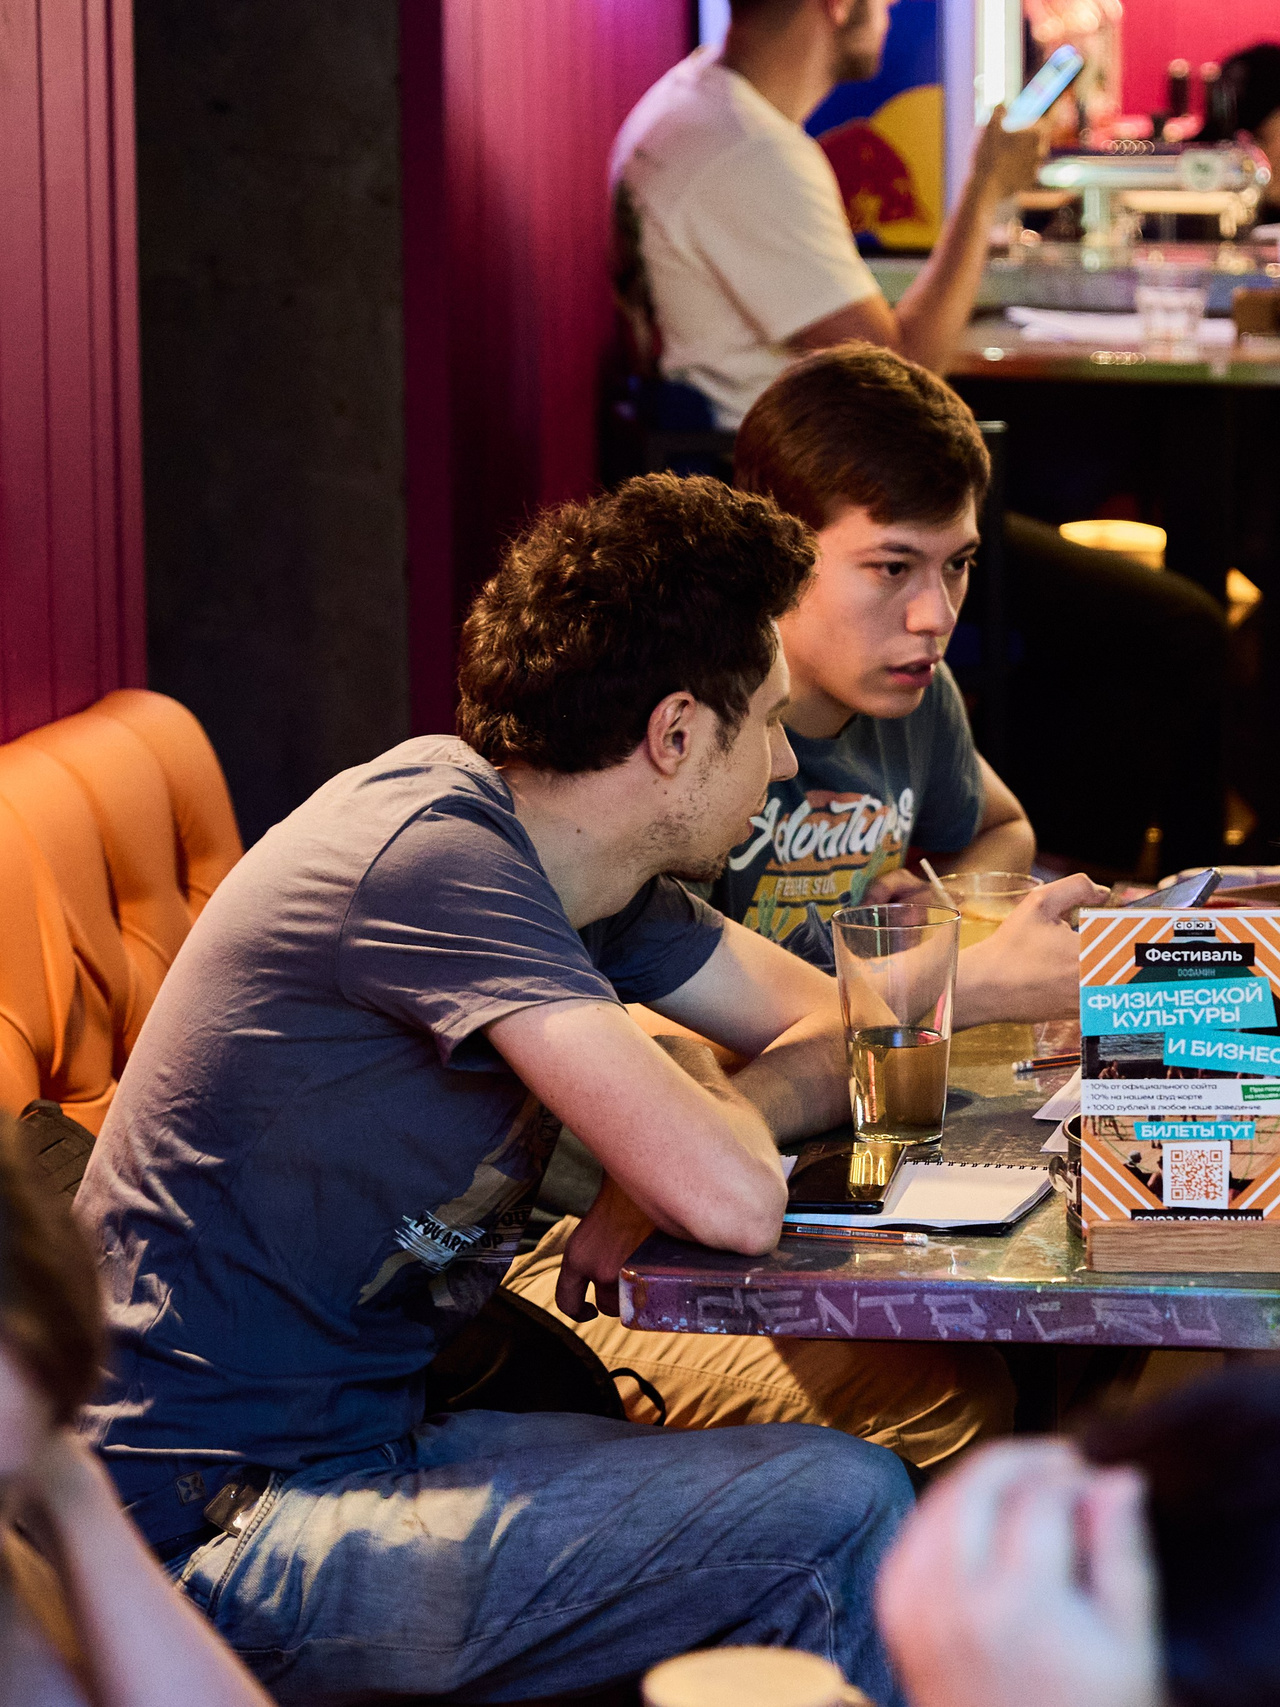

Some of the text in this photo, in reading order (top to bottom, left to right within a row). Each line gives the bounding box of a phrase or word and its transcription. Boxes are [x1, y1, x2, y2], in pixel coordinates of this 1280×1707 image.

[1175, 921, 1214, 930] СОЮЗ
[1145, 947, 1243, 962] Фестиваль
[1087, 981, 1263, 1011] ФИЗИЧЕСКОЙ
[1112, 1006, 1241, 1028] КУЛЬТУРЫ
[1167, 1038, 1186, 1055] И
[1121, 1083, 1189, 1091] официального
[1190, 1082, 1217, 1090] сайта
[1116, 1104, 1149, 1112] рублей
[1141, 1124, 1253, 1138] БИЛЕТЫ ТУТ
[414, 1212, 441, 1240] YOU
